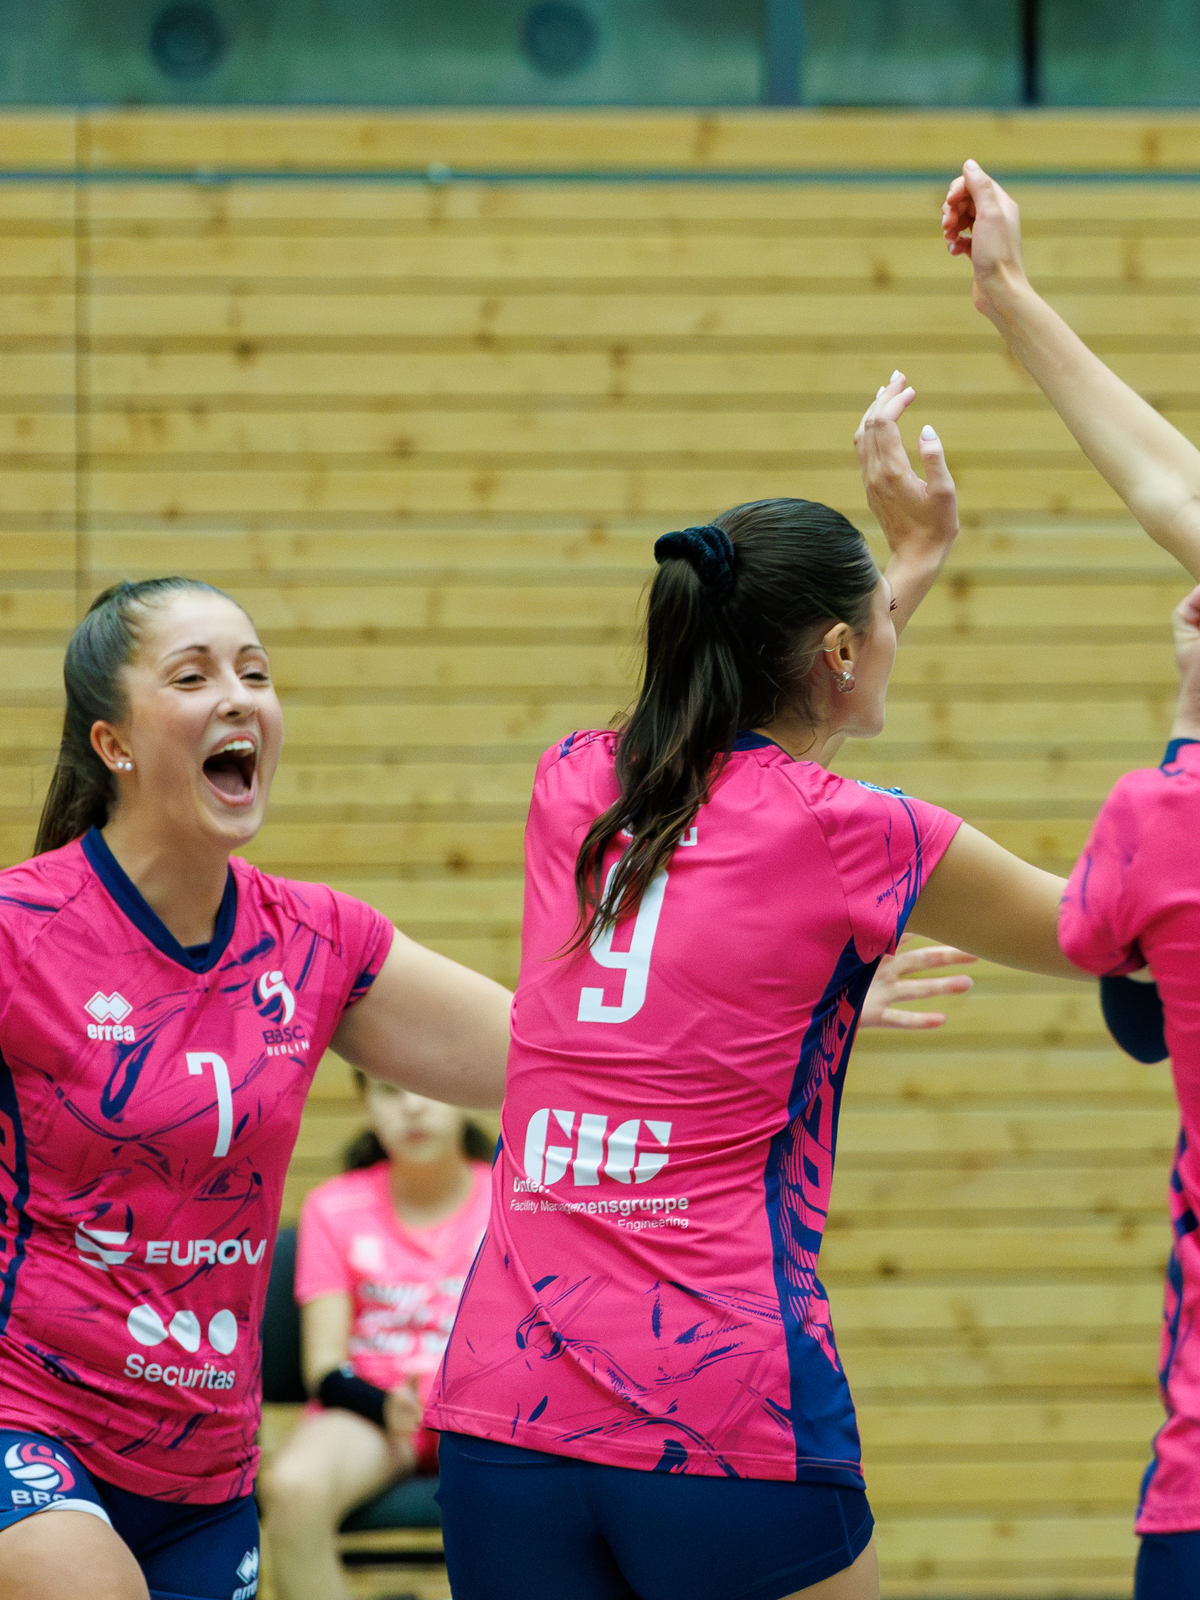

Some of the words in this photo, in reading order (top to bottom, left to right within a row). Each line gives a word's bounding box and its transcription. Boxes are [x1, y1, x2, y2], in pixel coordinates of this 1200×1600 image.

[577, 859, 668, 1024] 9
[87, 1023, 135, 1041] errea
[185, 1052, 233, 1158] 7
[123, 1353, 236, 1390] Securitas
